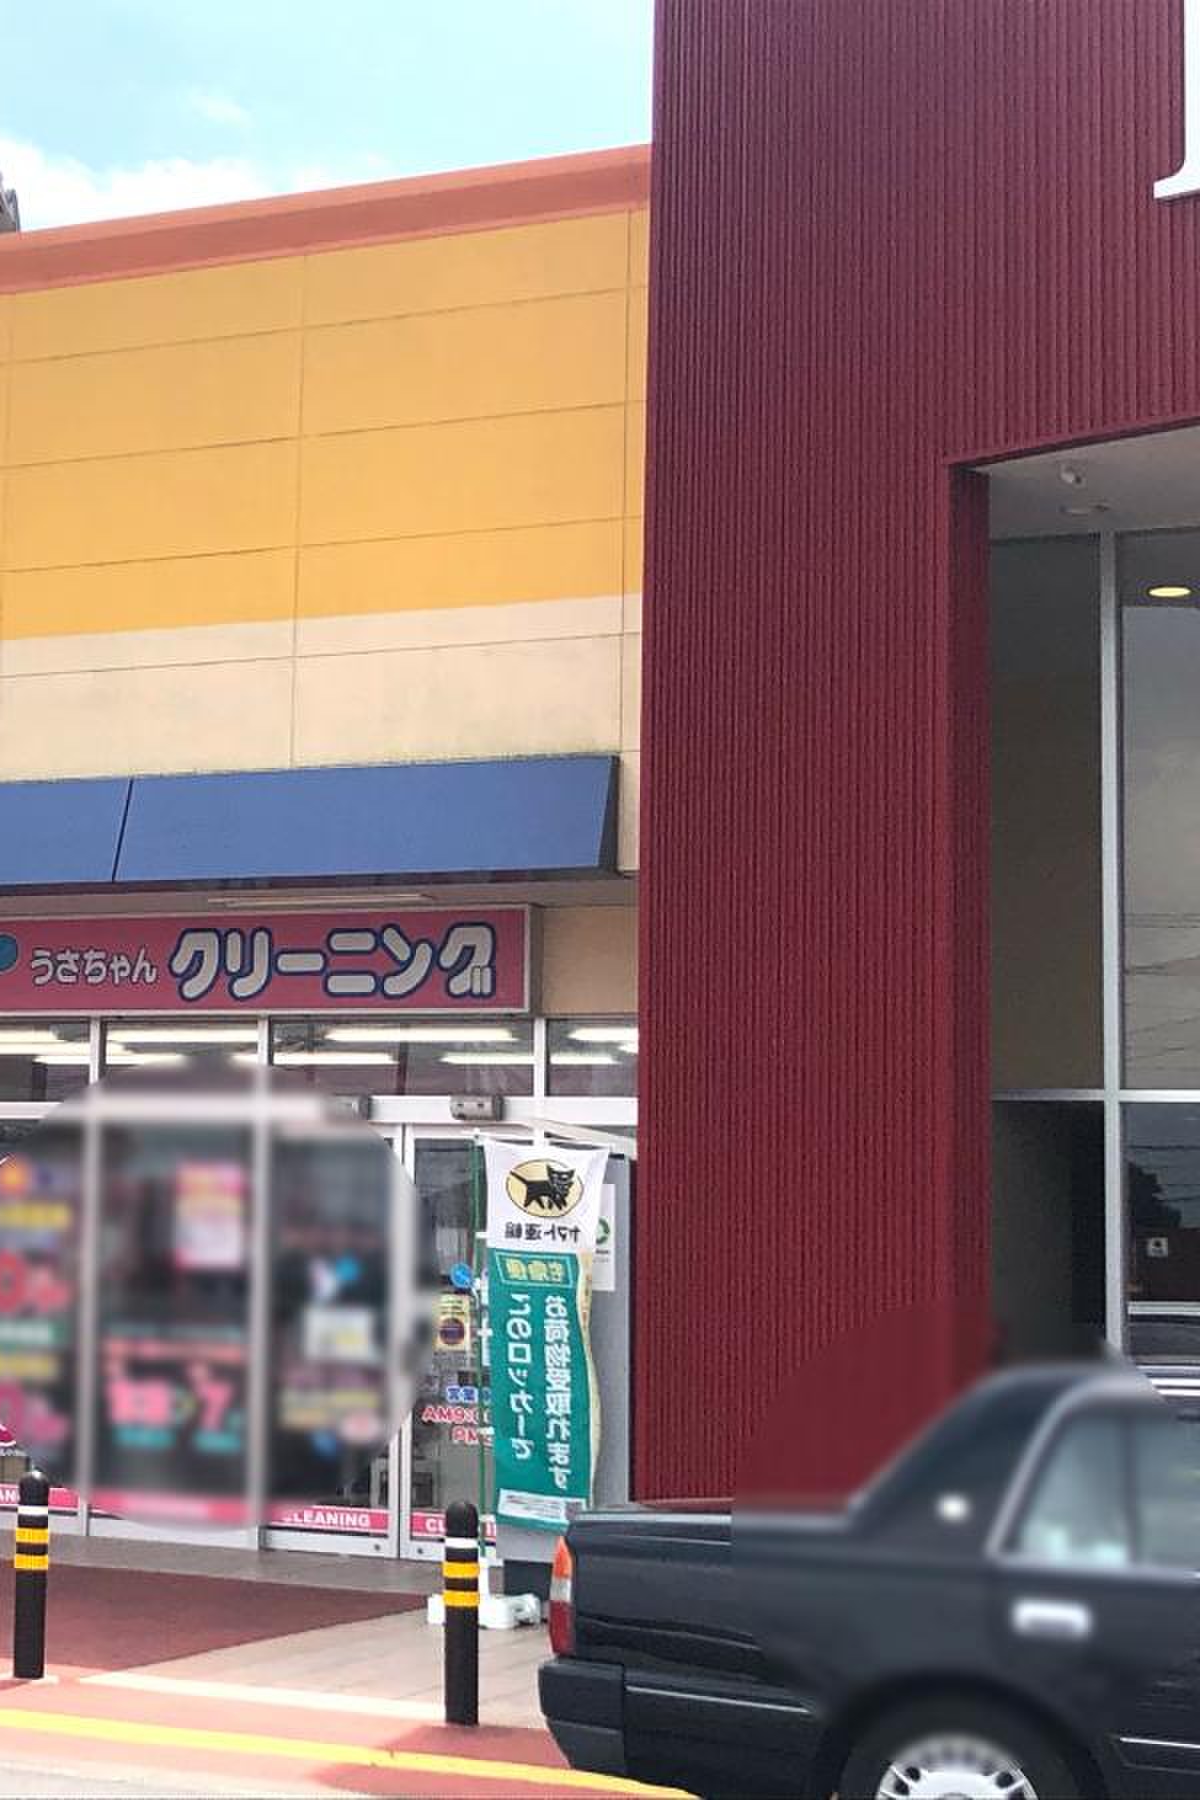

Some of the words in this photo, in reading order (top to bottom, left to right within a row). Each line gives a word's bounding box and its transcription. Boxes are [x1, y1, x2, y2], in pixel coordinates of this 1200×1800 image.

[30, 947, 157, 985] うさちゃん
[168, 922, 498, 1001] クリーニング
